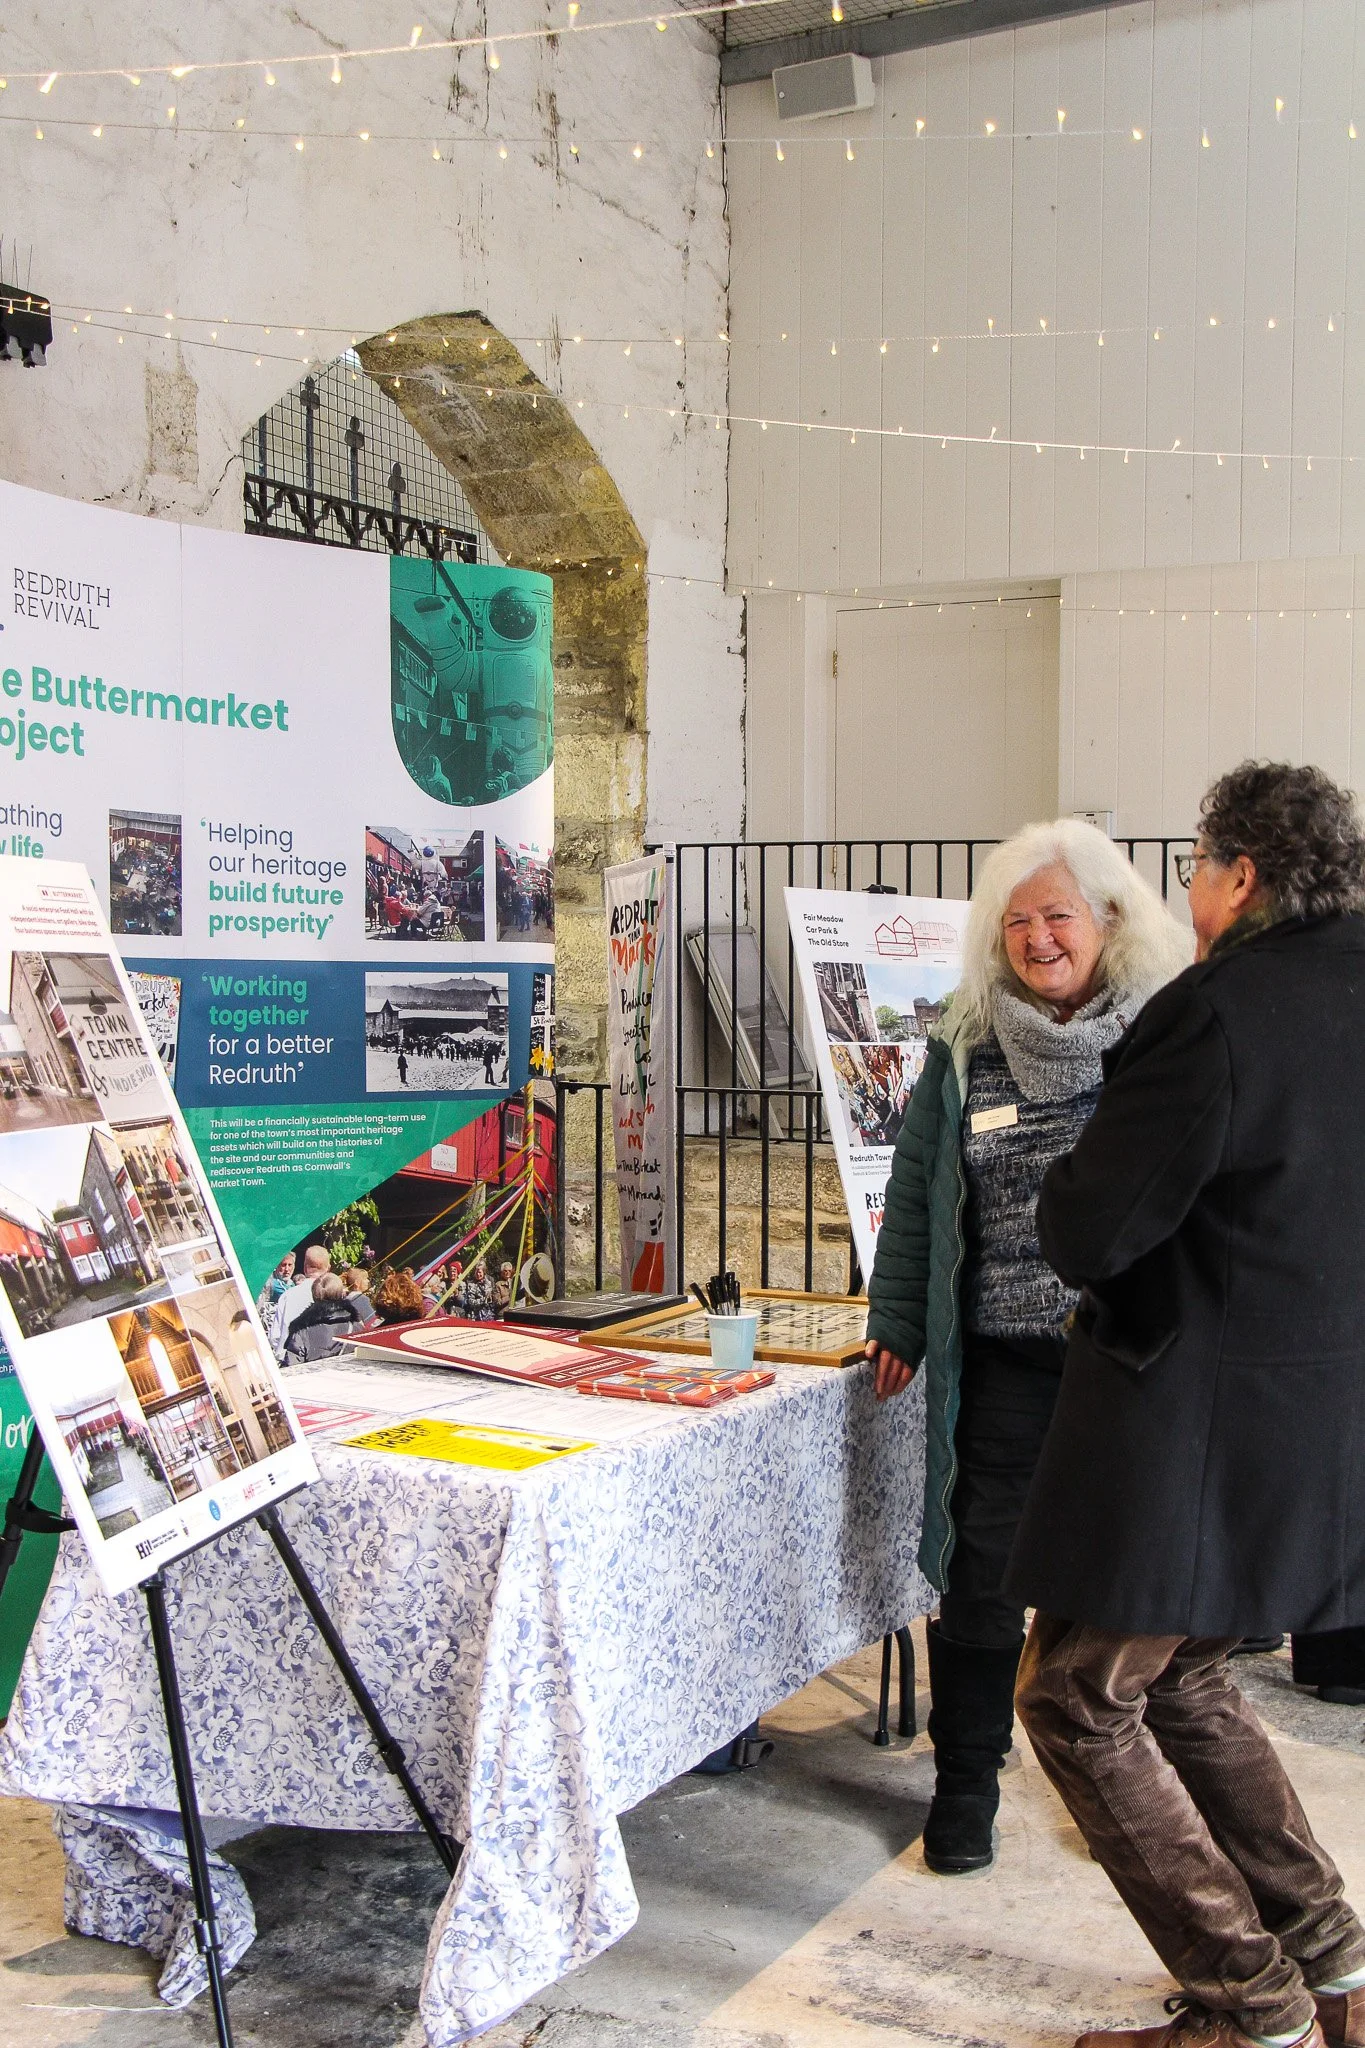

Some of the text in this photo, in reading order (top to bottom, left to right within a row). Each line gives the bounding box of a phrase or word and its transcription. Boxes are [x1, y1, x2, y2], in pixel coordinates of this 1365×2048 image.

[14, 567, 110, 608] REDRUTH
[14, 593, 99, 630] REVIVAL
[32, 666, 289, 732] Buttermarket
[12, 834, 44, 859] life
[209, 853, 347, 883] our heritage
[209, 880, 344, 906] build future
[610, 899, 659, 936] REDRUT
[817, 915, 844, 923] Meadow
[808, 938, 820, 946] The
[820, 938, 832, 946] Old
[83, 1014, 131, 1034] TOWN
[209, 1004, 309, 1032] together
[86, 1038, 148, 1059] CENTRE
[208, 1033, 335, 1055] for a better
[109, 1074, 138, 1092] INDIE
[210, 1119, 227, 1128] This
[229, 1118, 243, 1127] will
[244, 1118, 256, 1127] be
[265, 1116, 310, 1127] financially
[312, 1115, 362, 1124] sustainable
[364, 1114, 409, 1124] long-term
[210, 1131, 222, 1140] for
[241, 1130, 250, 1139] of
[251, 1129, 265, 1138] the
[297, 1128, 319, 1136] most
[320, 1126, 365, 1137] important
[366, 1125, 403, 1135] heritage
[210, 1136, 383, 1152] assets which will build on the histories of
[210, 1149, 355, 1164] the site and our communities and
[849, 1154, 874, 1162] Redruth
[210, 1166, 254, 1176] rediscover
[256, 1164, 290, 1173] Redruth
[292, 1164, 303, 1172] as
[210, 1178, 267, 1188] Market Town.
